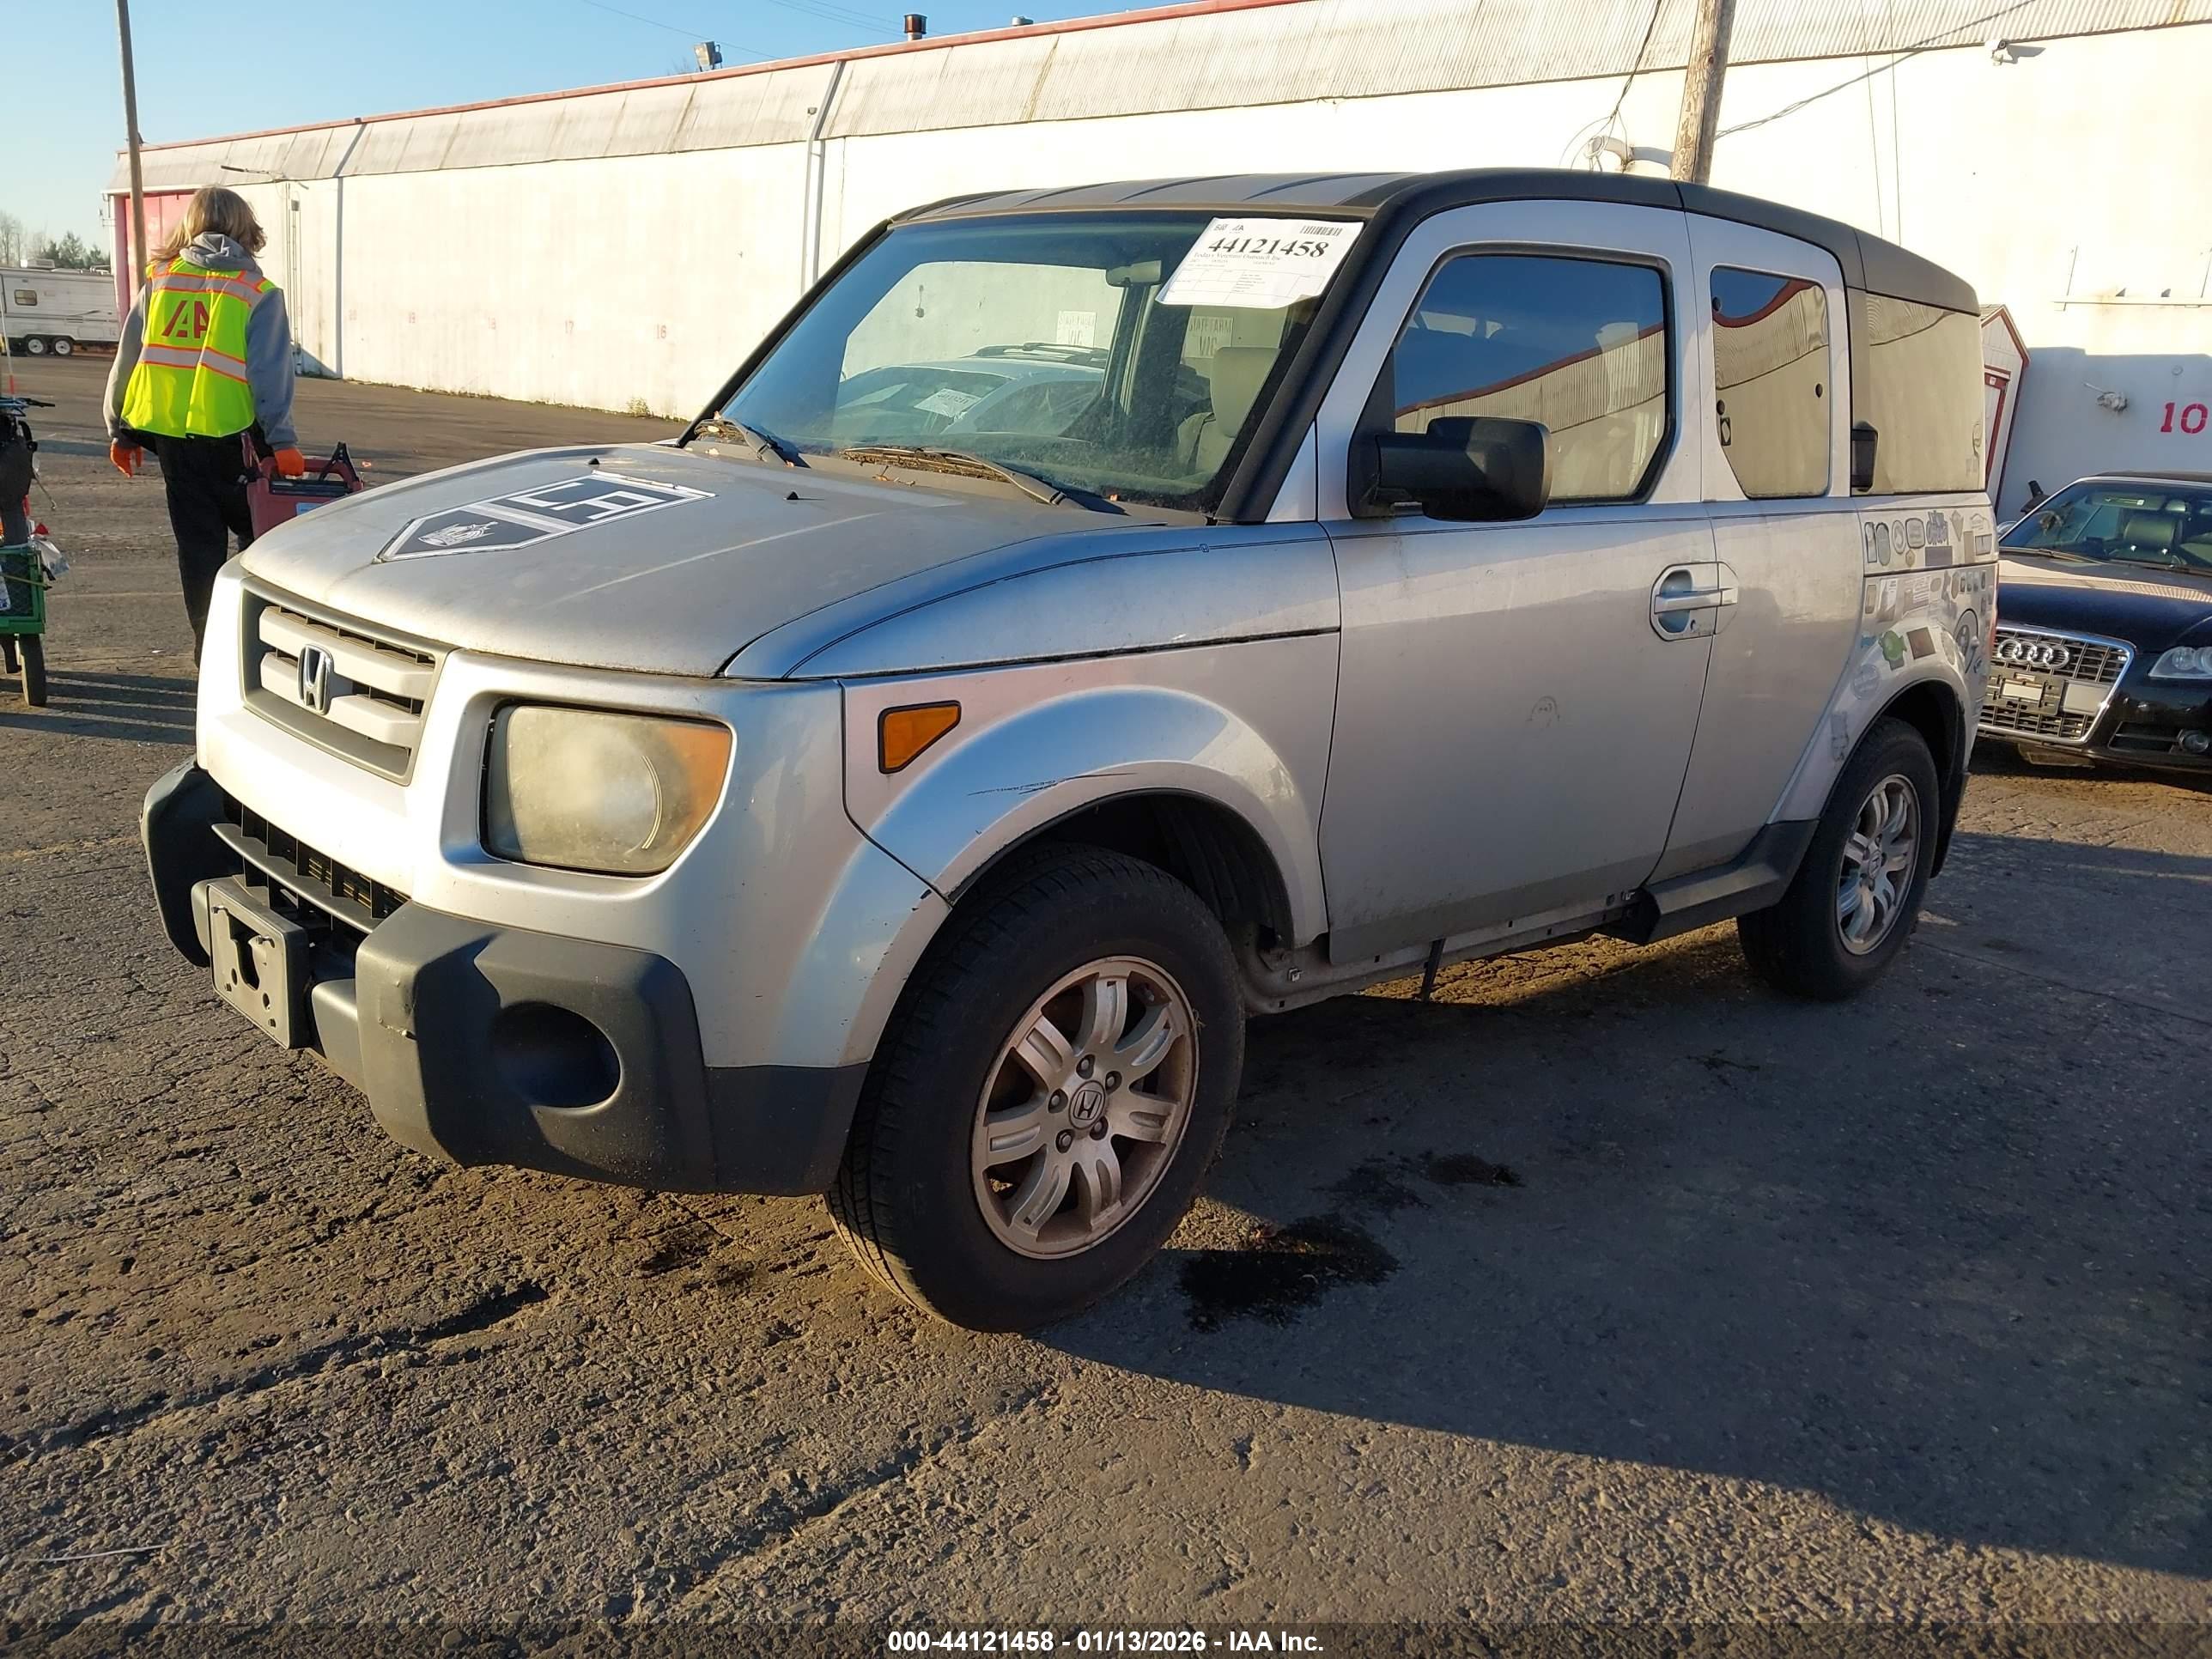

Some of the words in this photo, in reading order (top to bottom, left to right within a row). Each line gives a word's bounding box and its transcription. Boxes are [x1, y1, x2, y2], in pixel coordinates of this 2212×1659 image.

[1208, 237, 1329, 258] 44121458
[657, 324, 667, 339] 16
[2160, 402, 2208, 434] 10
